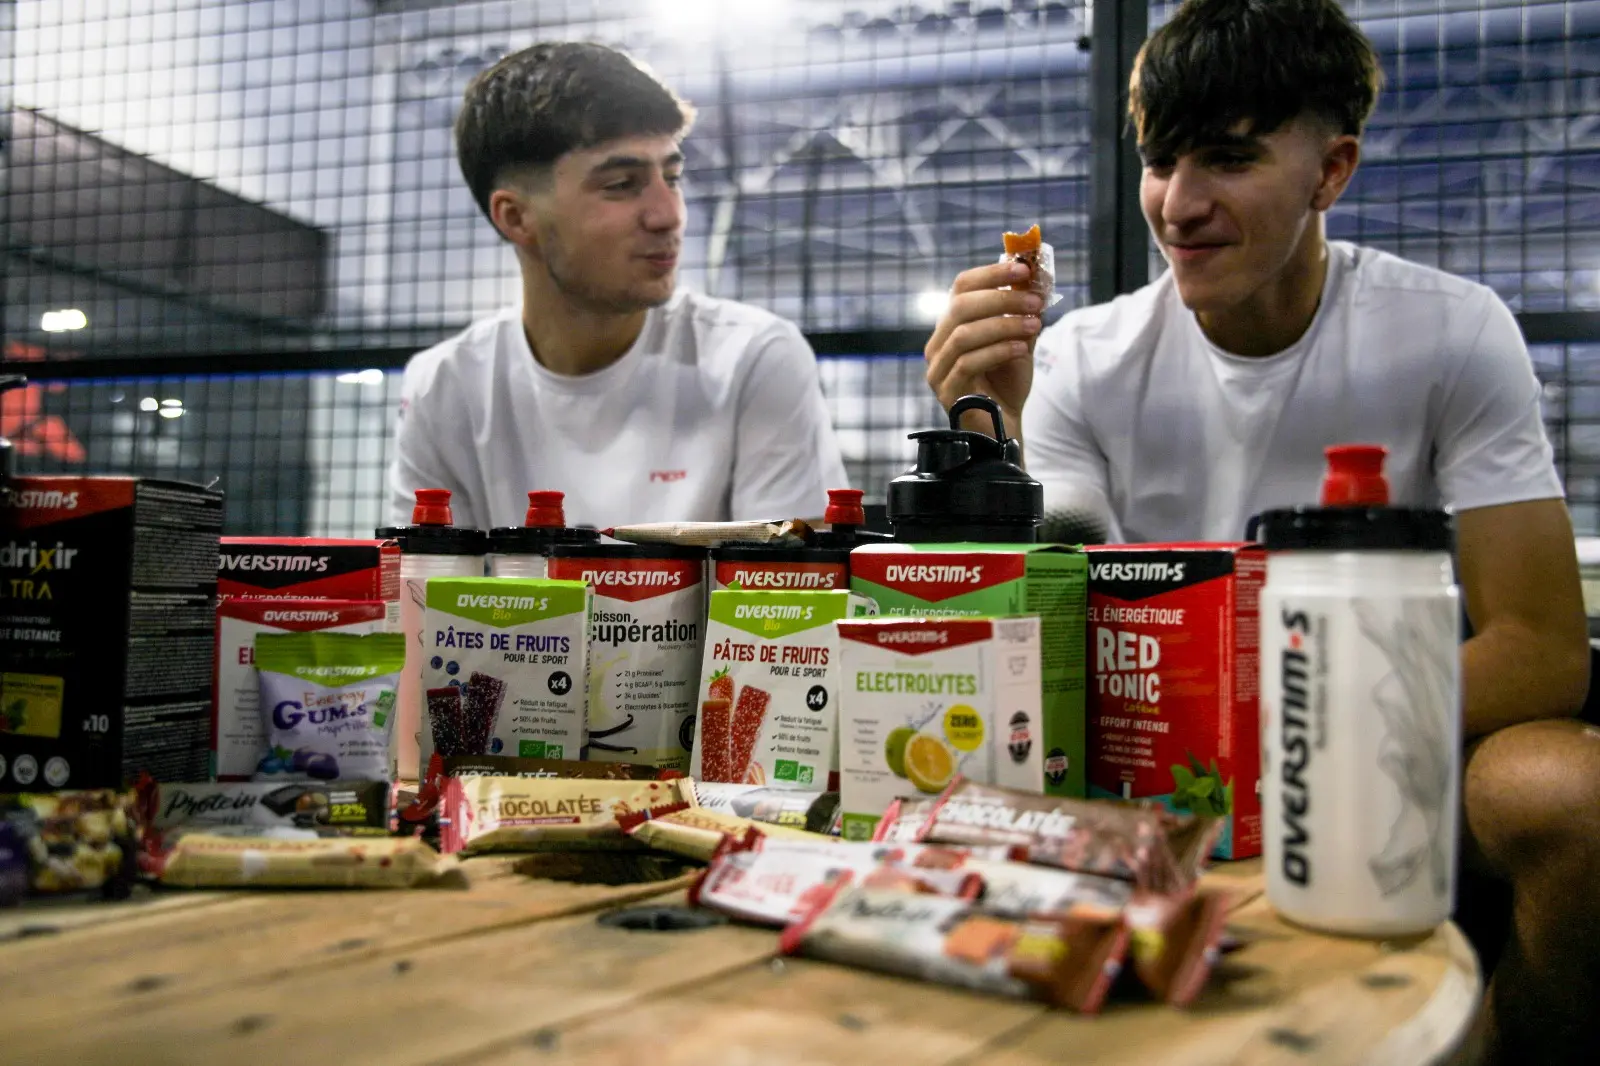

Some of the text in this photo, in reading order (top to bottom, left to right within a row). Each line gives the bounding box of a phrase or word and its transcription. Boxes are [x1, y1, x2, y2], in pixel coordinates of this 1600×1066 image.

[0, 540, 79, 575] drixir
[1103, 603, 1186, 625] ÉNERGÉTIQUE
[435, 625, 570, 653] PÂTES DE FRUITS
[1097, 626, 1161, 673] RED
[504, 653, 568, 665] POUR LE SPORT
[713, 637, 830, 665] PÂTES DE FRUITS
[551, 676, 568, 689] x4
[769, 665, 827, 678] POUR LE SPORT
[856, 671, 977, 696] ELECTROLYTES
[1096, 672, 1161, 704] TONIC
[808, 690, 824, 706] x4
[82, 713, 110, 734] x10
[1100, 716, 1170, 734] EFFORT INTENSE
